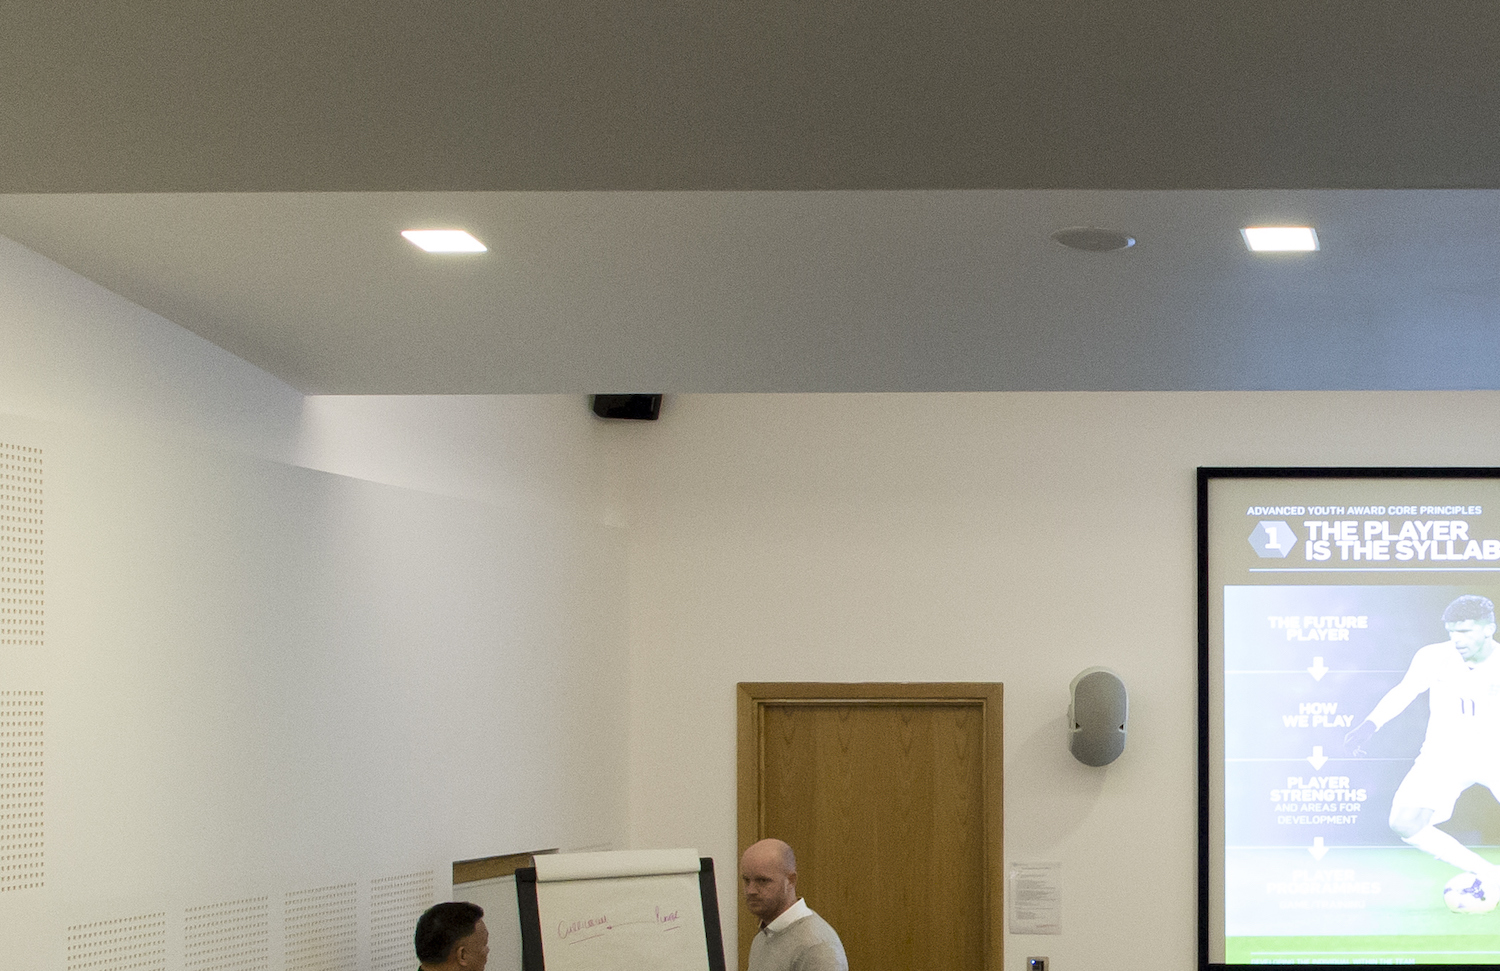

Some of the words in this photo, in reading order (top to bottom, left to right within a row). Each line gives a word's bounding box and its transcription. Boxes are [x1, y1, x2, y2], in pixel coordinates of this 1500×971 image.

[1247, 505, 1305, 515] ADVANCED
[1307, 505, 1345, 515] YOUTH
[1347, 505, 1386, 515] AWARD
[1388, 505, 1418, 515] CORE
[1420, 505, 1482, 515] PRINCIPLES
[1304, 521, 1359, 541] THE
[1363, 521, 1469, 541] PLAYER
[1264, 528, 1281, 549] 1
[1305, 540, 1330, 561] IS
[1336, 540, 1391, 561] THE
[1267, 616, 1300, 629] THE
[1303, 616, 1368, 629] FUTURE
[1286, 629, 1349, 641] PLAYER
[1299, 703, 1338, 715] HOW
[1282, 715, 1309, 727] WE
[1312, 715, 1354, 727] PLAY
[1287, 777, 1350, 789] PLAYER
[1270, 789, 1367, 802] STRENGTHS
[1274, 803, 1298, 812] AND
[1300, 803, 1337, 812] AREAS
[1339, 803, 1361, 812] FOR
[1277, 815, 1357, 825] DEVELOPMENT
[1292, 869, 1355, 882] PLAYER
[1266, 882, 1381, 894] PROGRAMMES
